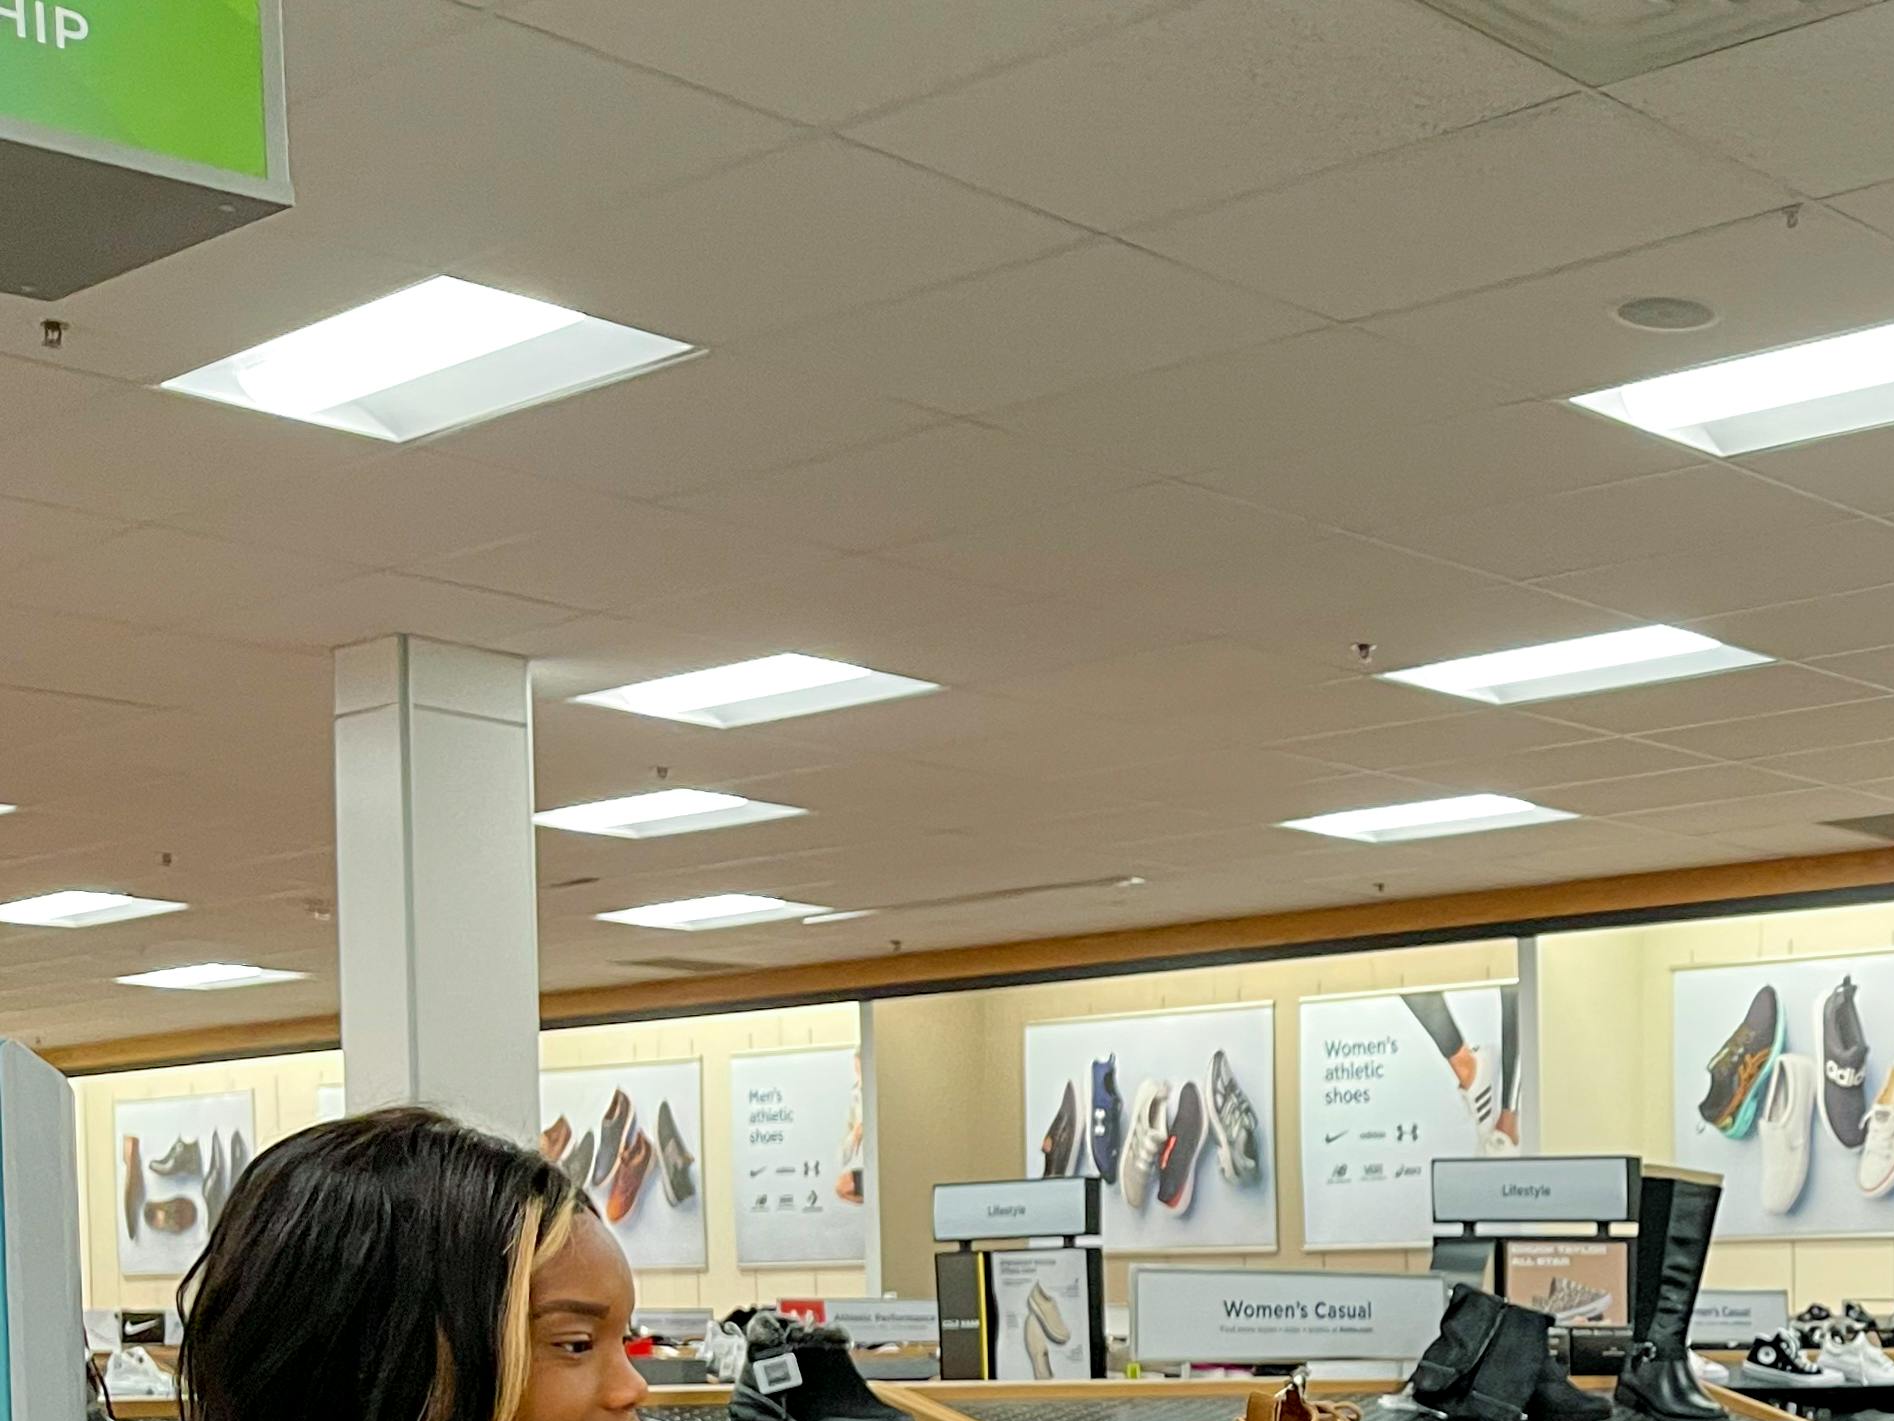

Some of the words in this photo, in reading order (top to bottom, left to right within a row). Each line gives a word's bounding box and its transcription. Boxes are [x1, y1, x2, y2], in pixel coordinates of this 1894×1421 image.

[1325, 1037, 1399, 1058] Women's
[1325, 1060, 1385, 1082] athletic
[749, 1088, 783, 1104] Men's
[1325, 1087, 1371, 1105] shoes
[750, 1108, 794, 1124] athletic
[750, 1129, 784, 1144] shoes
[1502, 1184, 1551, 1199] Lifestyle
[987, 1205, 1026, 1218] Lifestyle
[1223, 1300, 1309, 1319] Women's
[1314, 1301, 1373, 1319] Casual
